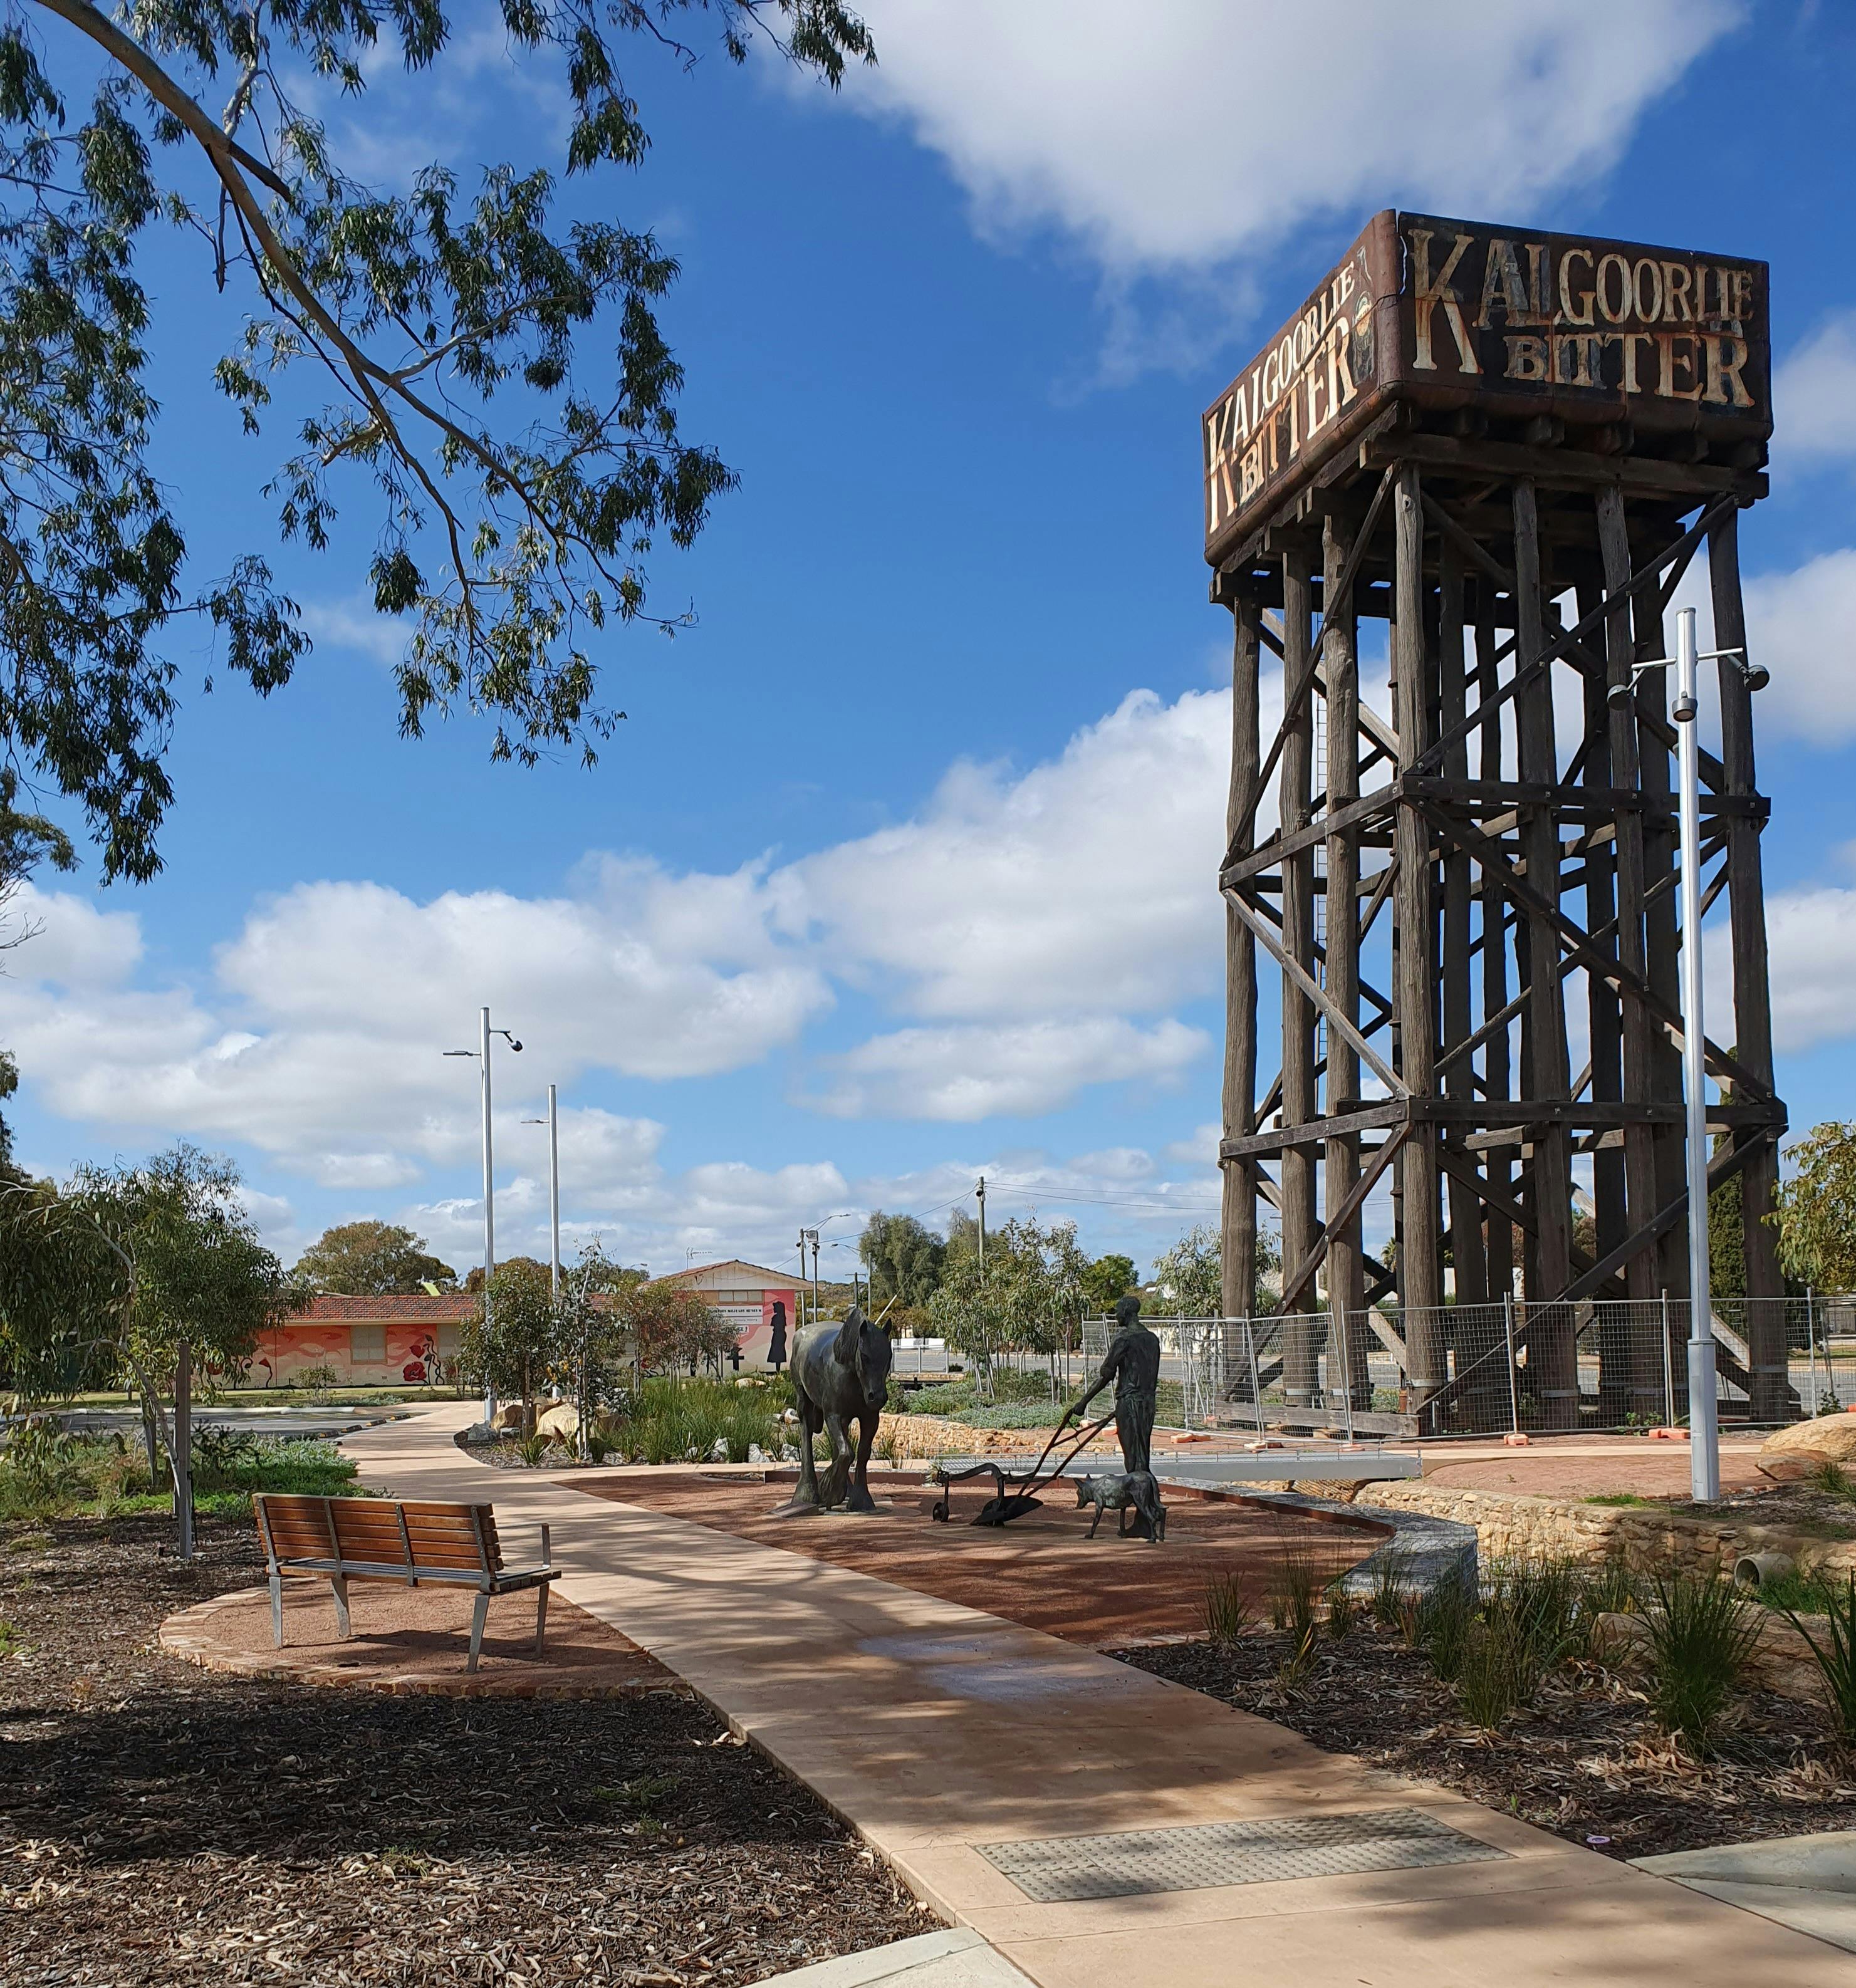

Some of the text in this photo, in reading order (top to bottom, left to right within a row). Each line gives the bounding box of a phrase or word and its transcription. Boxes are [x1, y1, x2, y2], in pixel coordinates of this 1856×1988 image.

[1407, 228, 1754, 374] KALGOORLIE
[1503, 332, 1755, 408] BITTER
[1207, 260, 1356, 534] KALGOORLIE
[1239, 316, 1358, 506] BITTER
